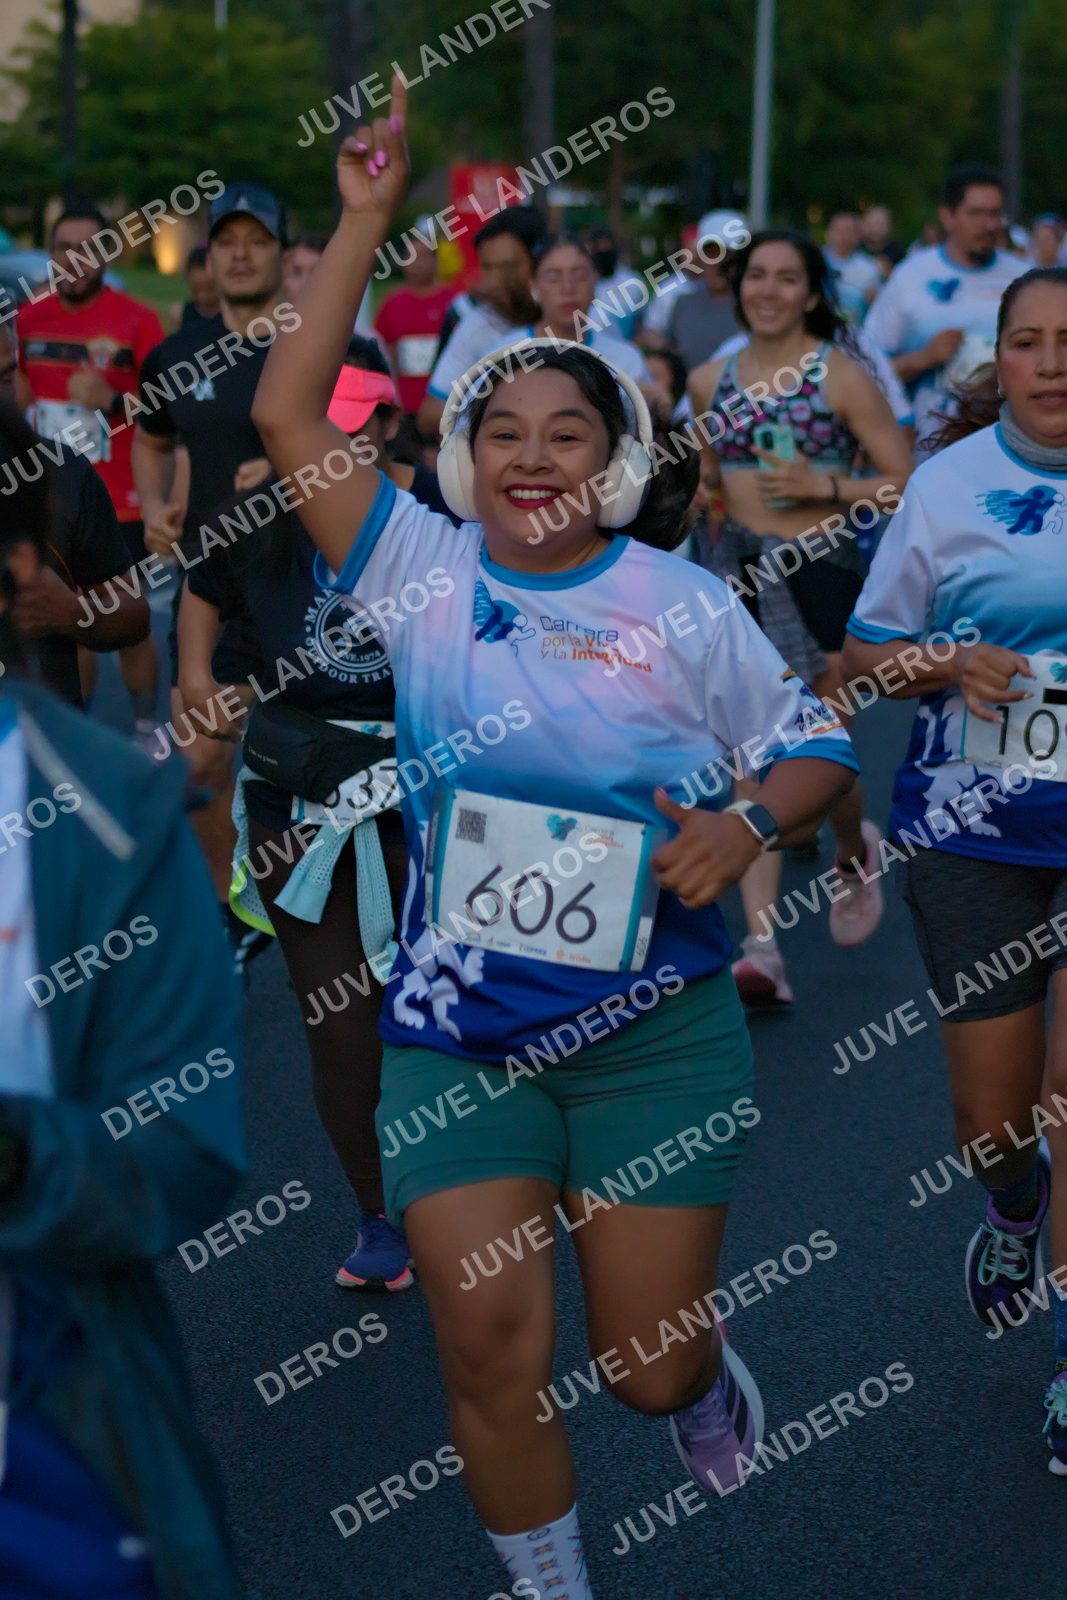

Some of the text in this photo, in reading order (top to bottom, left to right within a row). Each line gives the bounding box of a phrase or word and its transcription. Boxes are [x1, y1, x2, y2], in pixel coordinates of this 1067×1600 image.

[542, 635, 566, 649] por
[554, 647, 567, 660] la
[361, 666, 391, 683] TRA
[996, 705, 1067, 761] 10
[321, 766, 398, 809] 37
[465, 865, 596, 944] 606
